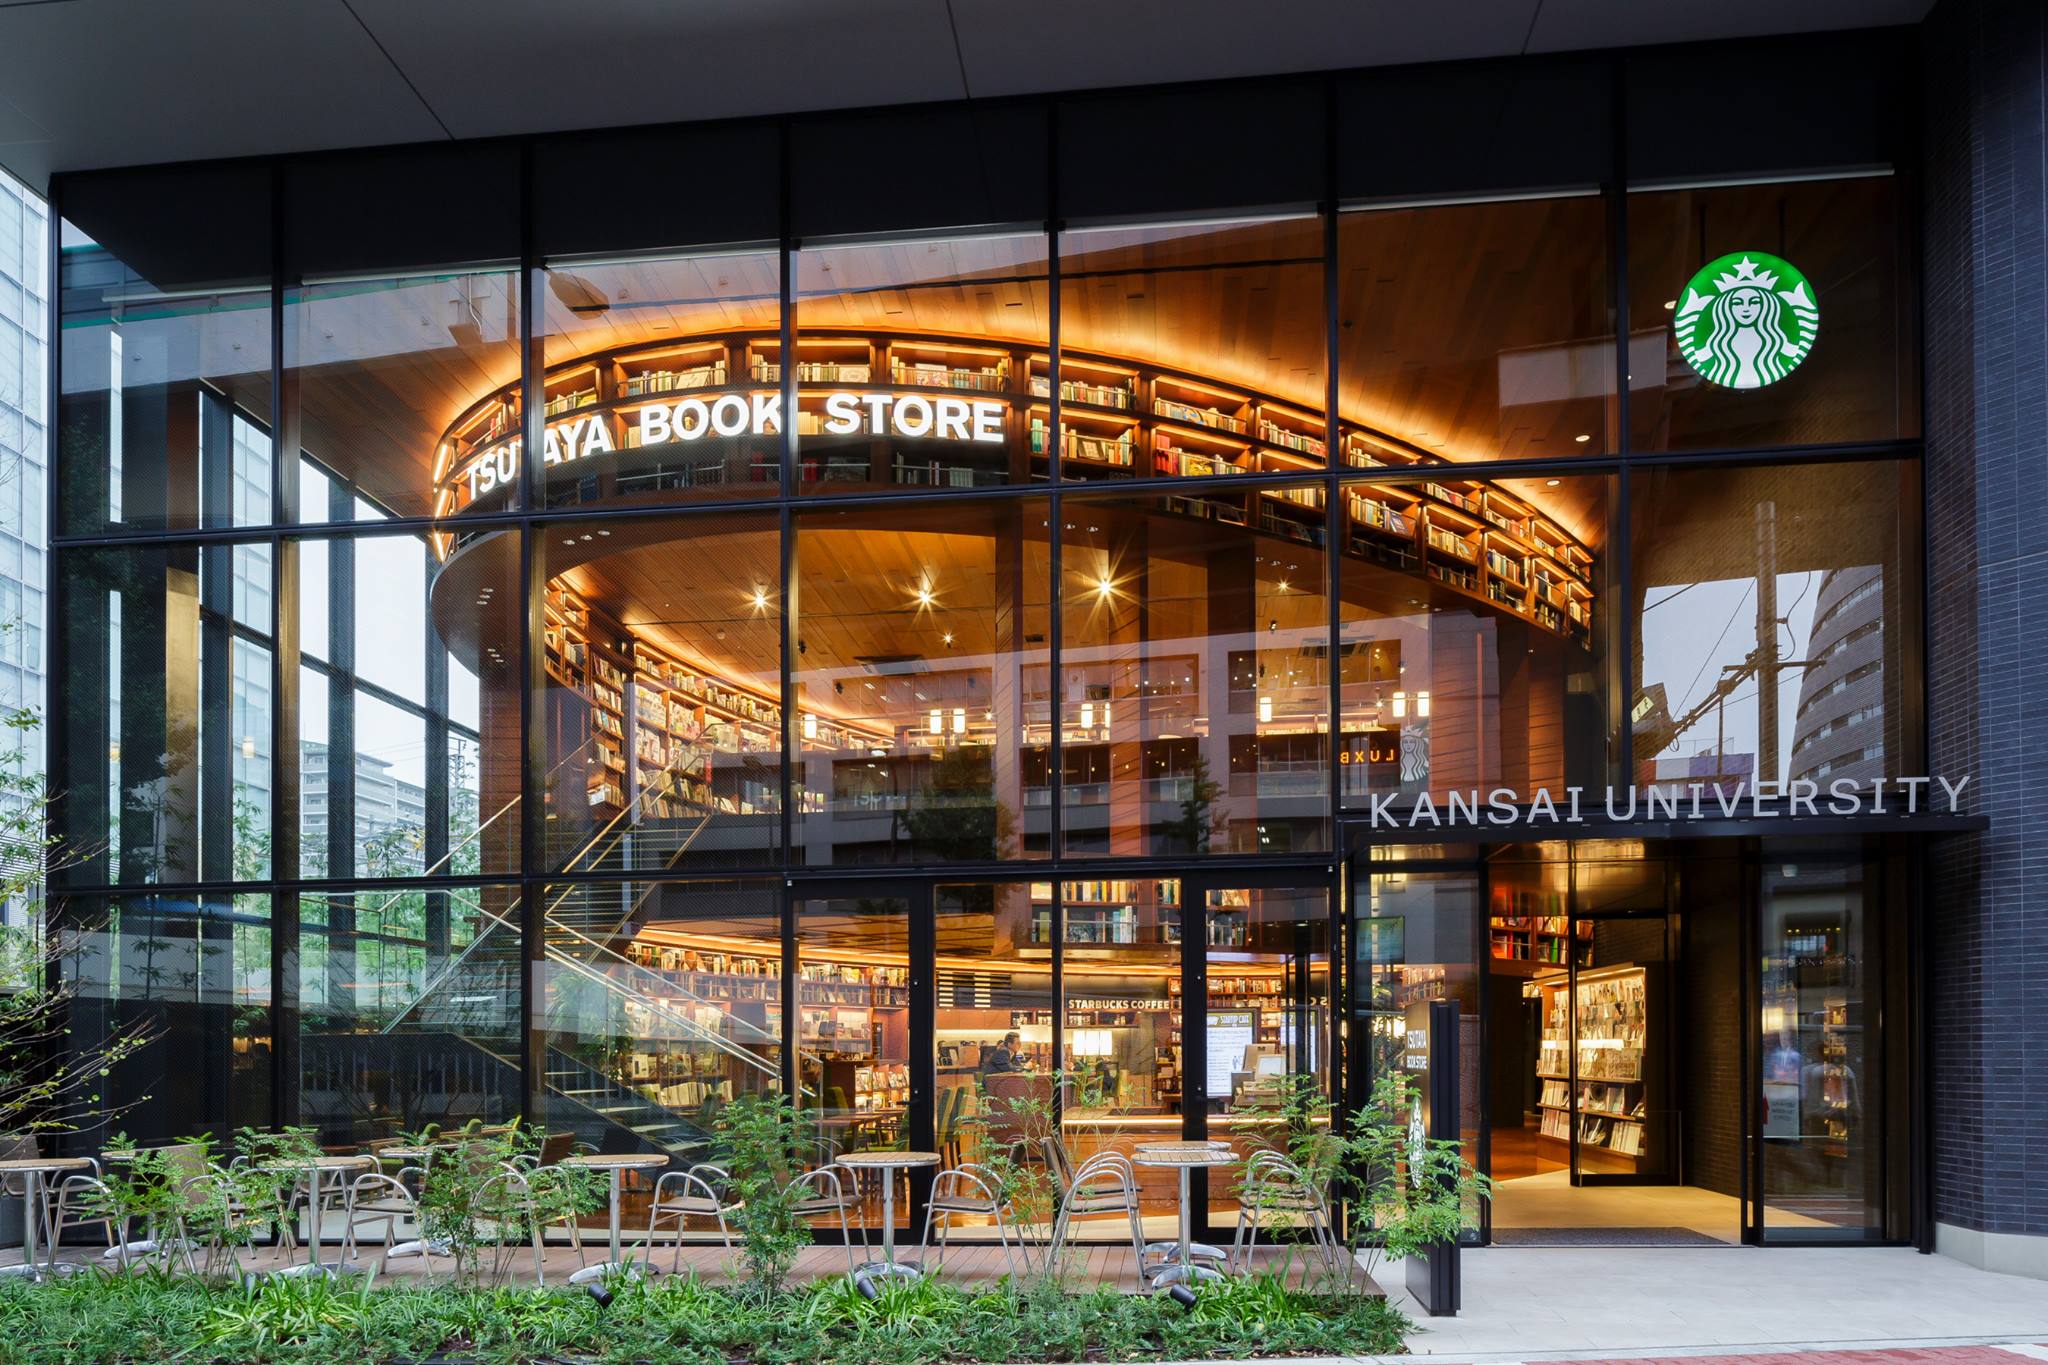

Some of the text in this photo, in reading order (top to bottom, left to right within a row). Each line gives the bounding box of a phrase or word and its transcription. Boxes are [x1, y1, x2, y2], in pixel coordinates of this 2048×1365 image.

[467, 394, 1005, 501] TSUAYA BOOK STORE
[1370, 775, 1972, 829] KANSAI UNIVERSITY
[1068, 999, 1170, 1010] STARBUCKS COFFEE
